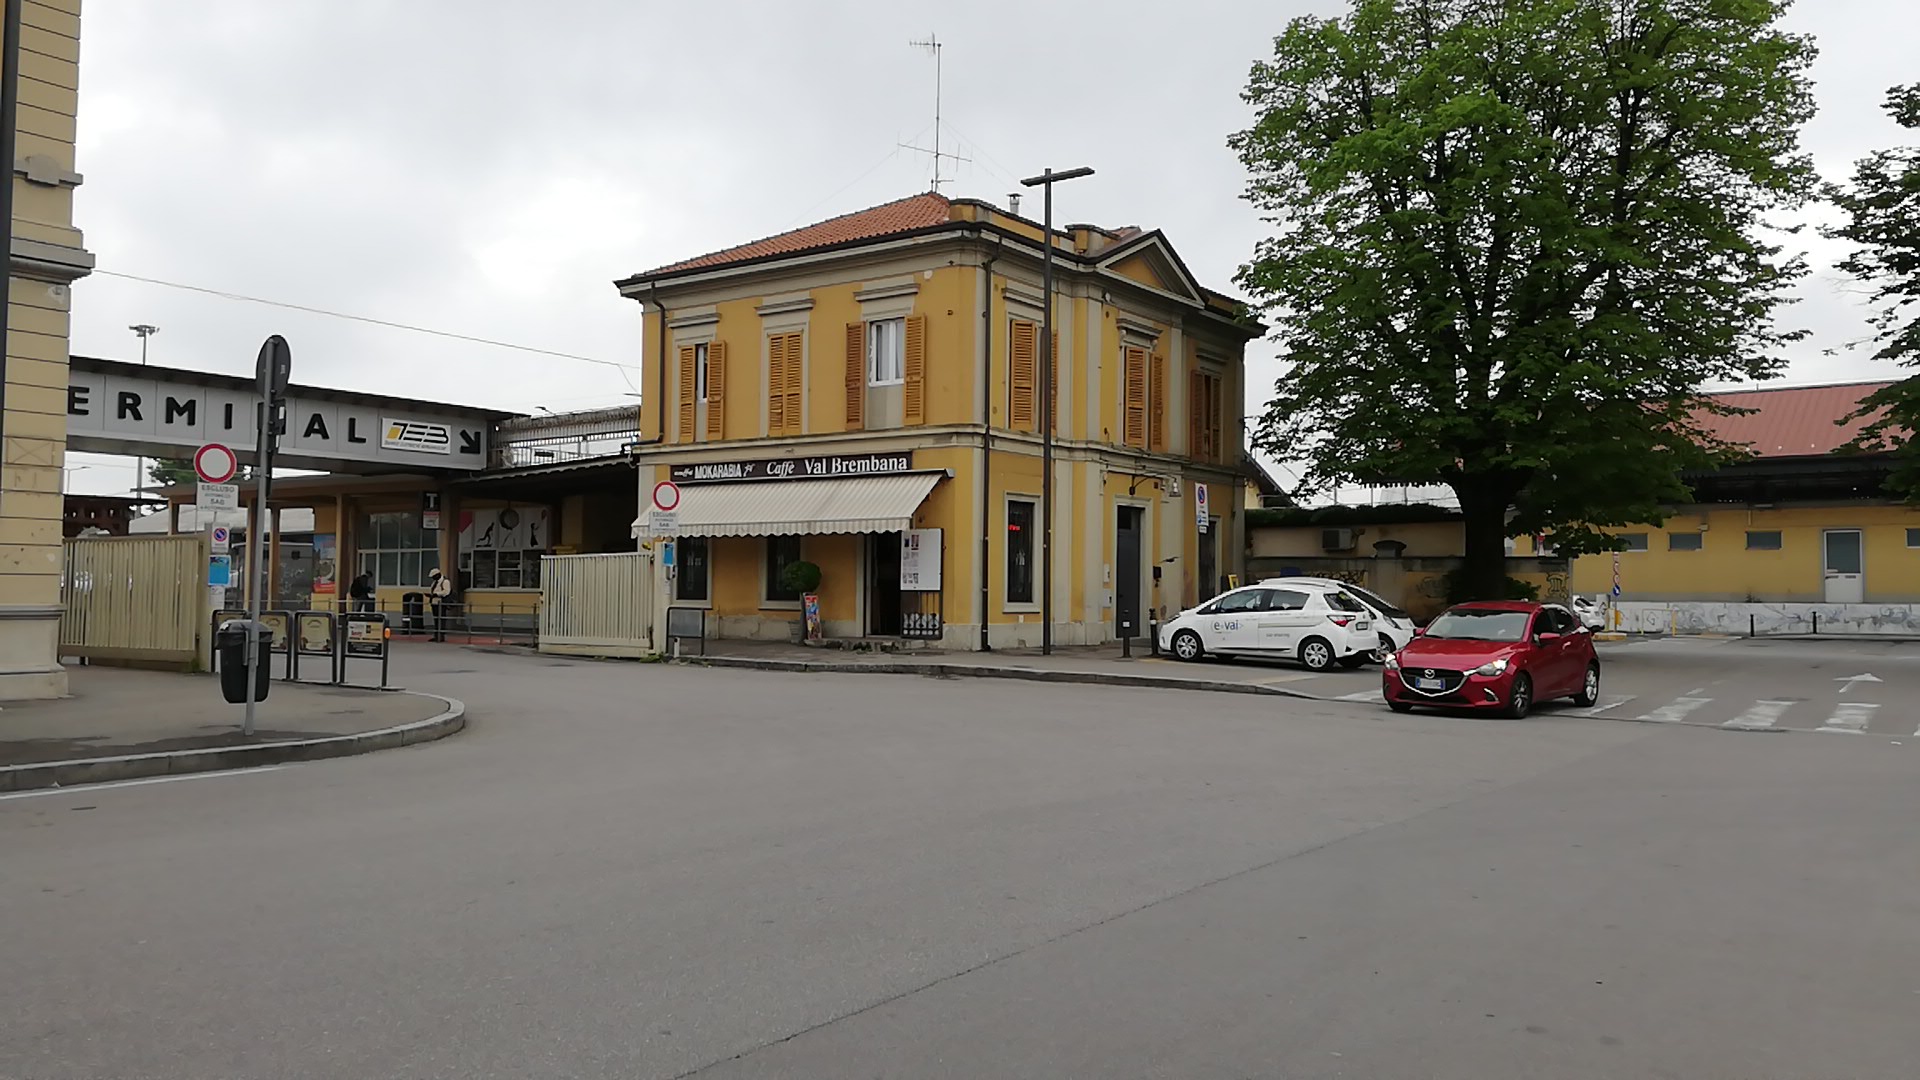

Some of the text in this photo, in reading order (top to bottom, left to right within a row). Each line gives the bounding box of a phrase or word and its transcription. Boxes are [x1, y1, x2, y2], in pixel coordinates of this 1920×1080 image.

[67, 385, 367, 444] ERMIAL
[694, 463, 742, 478] MOKARABIA
[805, 458, 826, 474] Val
[831, 455, 908, 473] Brembana
[426, 493, 438, 508] T
